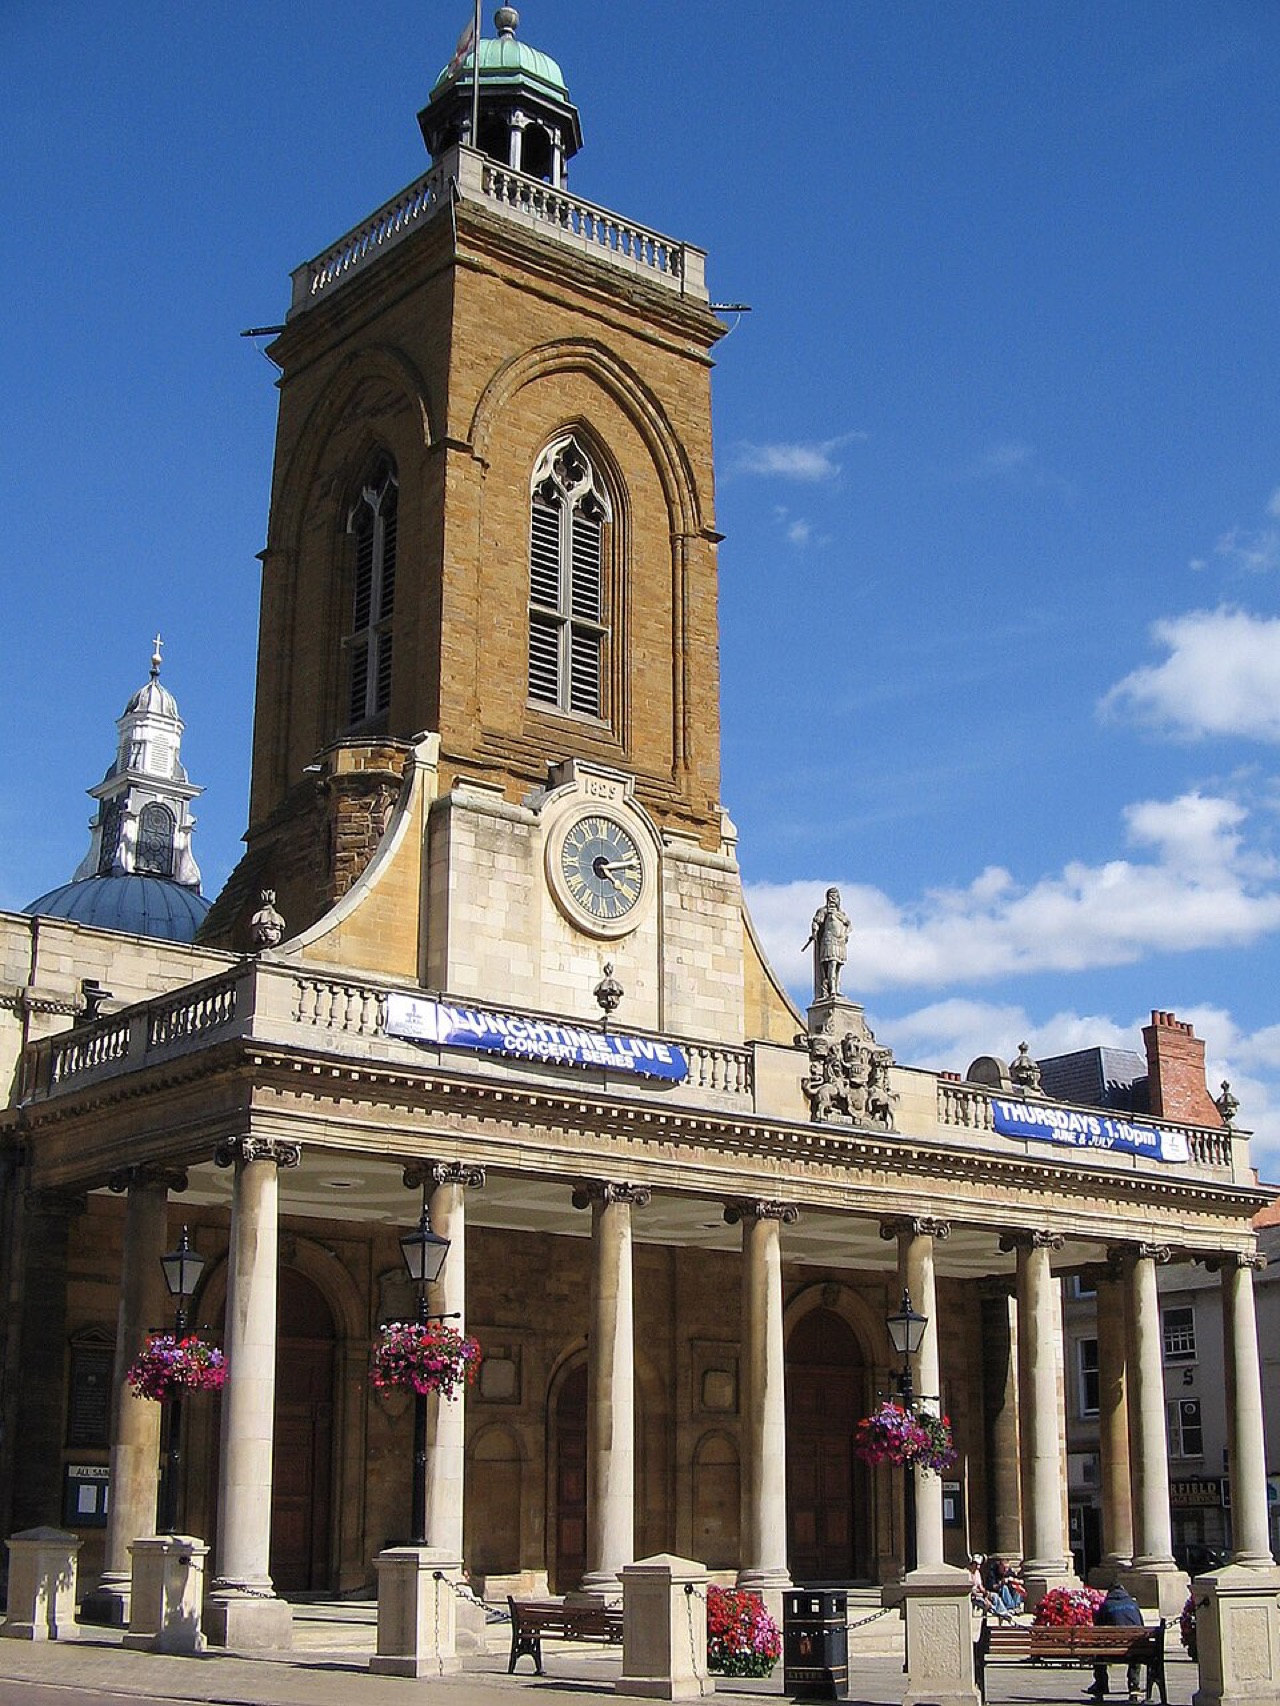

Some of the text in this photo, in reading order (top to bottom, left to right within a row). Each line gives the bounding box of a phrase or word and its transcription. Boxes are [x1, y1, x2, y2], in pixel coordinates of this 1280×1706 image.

[451, 1008, 673, 1064] LUNCHTIME LIVE
[504, 1035, 634, 1069] CONCERT SERIES
[998, 1101, 1156, 1146] THURSDAYS 1.10pm
[1051, 1128, 1114, 1149] JUNE & JULY
